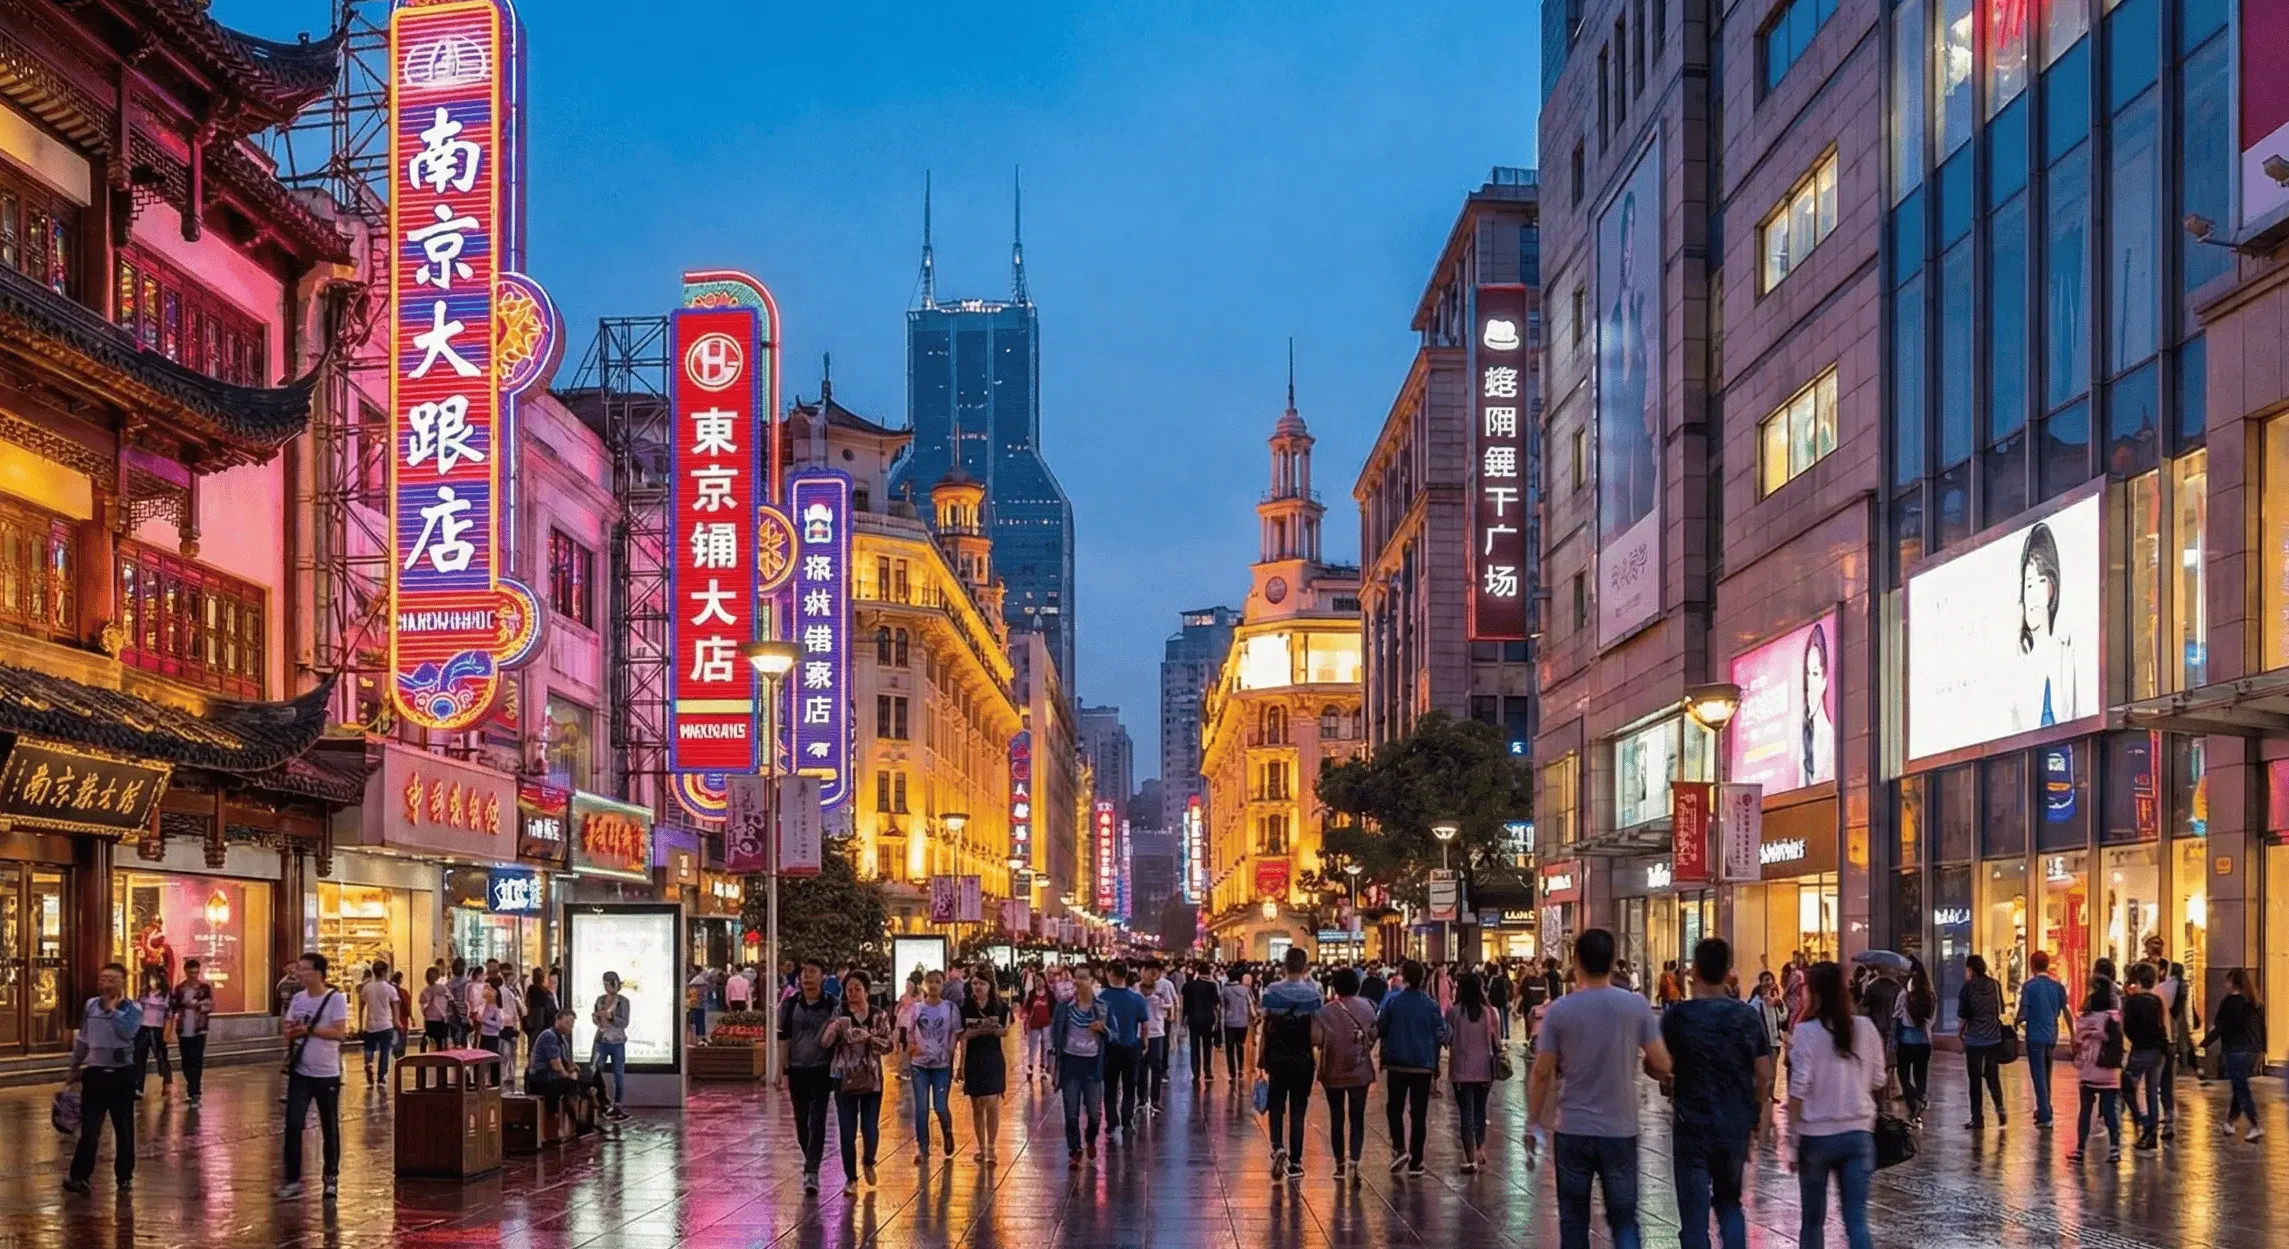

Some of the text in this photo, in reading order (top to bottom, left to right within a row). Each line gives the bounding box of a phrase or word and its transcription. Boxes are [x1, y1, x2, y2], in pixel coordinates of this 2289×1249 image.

[405, 107, 485, 573] 南京大跟店
